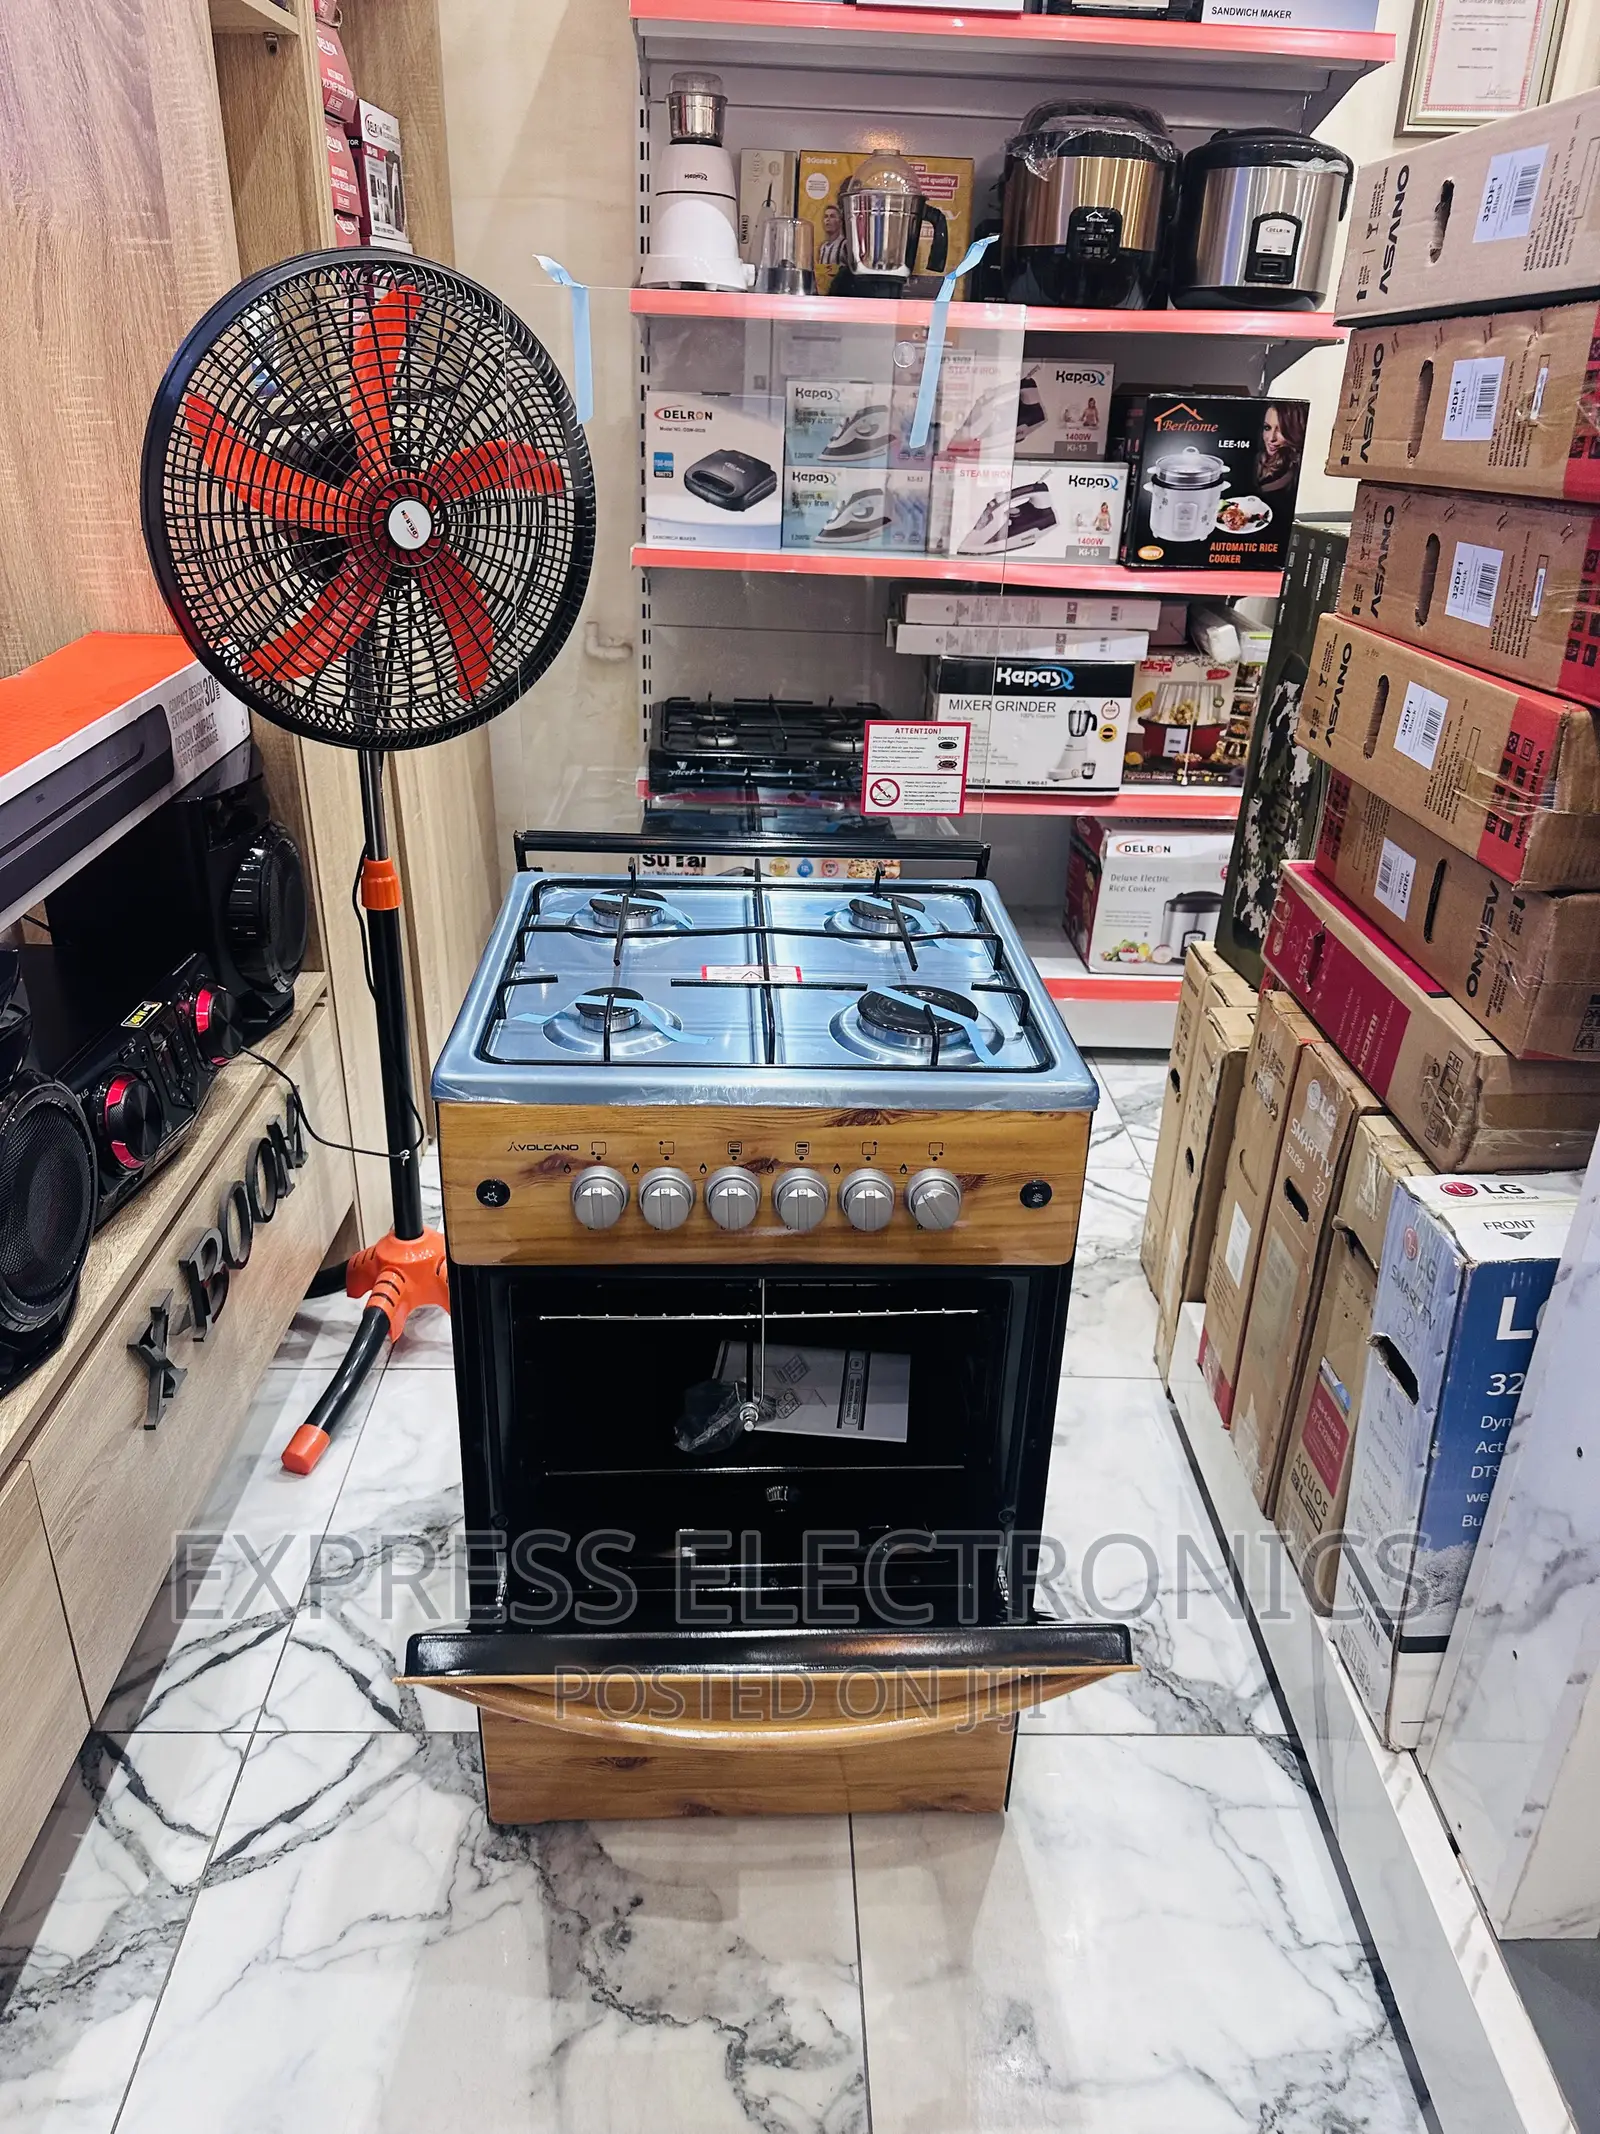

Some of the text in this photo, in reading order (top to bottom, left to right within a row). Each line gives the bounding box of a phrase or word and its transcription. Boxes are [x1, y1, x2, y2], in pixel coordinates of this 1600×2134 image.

[1211, 6, 1292, 19] SANDWICH MAKER
[930, 177, 956, 186] quality
[1483, 177, 1498, 221] 32DF1
[1379, 165, 1409, 294] ASANO
[1056, 370, 1098, 385] Kepas
[795, 387, 834, 400] Kepas
[1449, 380, 1462, 421] 32DF1
[1458, 387, 1467, 415] Black
[1360, 343, 1384, 463] ASANO
[663, 409, 713, 421] DELRON
[1065, 432, 1091, 442] 1400W
[1218, 439, 1250, 449] LEE-104
[792, 471, 829, 484] Kepas
[960, 469, 990, 478] STEAM
[1068, 474, 1111, 489] Kepas
[1077, 537, 1104, 546] 1400W
[1209, 542, 1279, 553] AUTOMATIC RICE
[1208, 554, 1242, 564] COOKER
[1370, 505, 1394, 618] ASANO
[1452, 561, 1463, 599] 32DF1
[1459, 570, 1468, 595] Black
[996, 667, 1062, 688] Kepas
[203, 675, 215, 706] 3D
[1325, 643, 1352, 748] ASANO
[949, 699, 1057, 713] MIXER GRINDER
[1401, 701, 1413, 736] 32DF1
[1408, 710, 1416, 733] Black
[895, 727, 942, 735] ATTENTION!
[1124, 845, 1171, 854] DELRON
[1110, 873, 1171, 883] Deluxe Electric
[1401, 870, 1411, 903] 32DF1
[1108, 884, 1157, 894] Rice Cooker
[1467, 880, 1500, 998] ASANO
[1296, 955, 1310, 983] LED
[1358, 1013, 1379, 1071] HDMI
[81, 1088, 90, 1100] LG
[1319, 1094, 1334, 1127] LG
[517, 1143, 579, 1151] VOLCANO
[1291, 1118, 1333, 1178] SMART TV
[1312, 1176, 1326, 1202] 32
[1480, 1183, 1525, 1195] LG
[1483, 1219, 1536, 1230] FRONT
[1486, 1373, 1527, 1396] 32
[1317, 1398, 1341, 1443] SHARP
[1480, 1415, 1512, 1432] Dyn
[1475, 1441, 1505, 1454] Act
[1296, 1454, 1329, 1517] AQUOS
